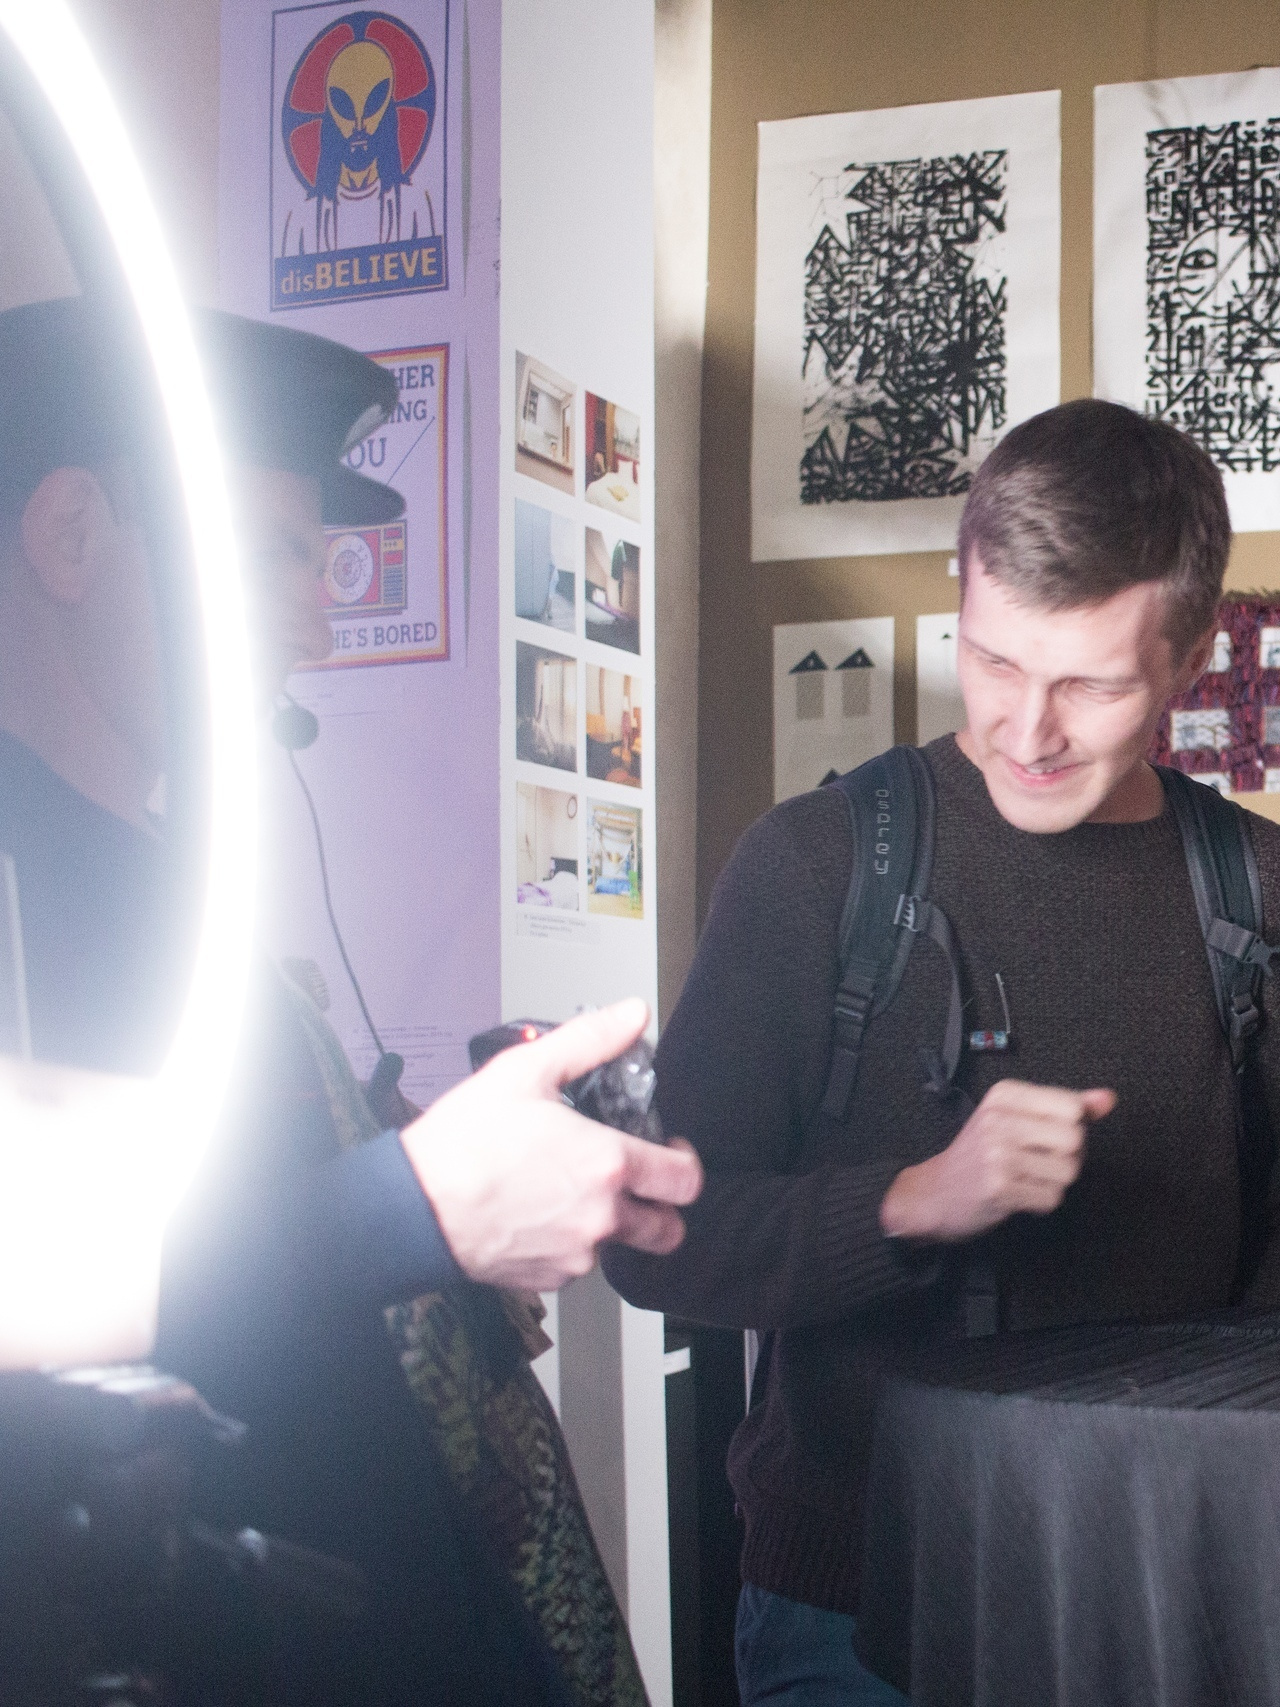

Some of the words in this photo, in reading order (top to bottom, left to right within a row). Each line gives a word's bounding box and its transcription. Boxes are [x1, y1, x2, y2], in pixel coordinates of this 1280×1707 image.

[280, 247, 438, 295] disBELIEVE
[347, 437, 387, 469] OU
[373, 621, 437, 647] BORED
[874, 789, 891, 875] osprey
